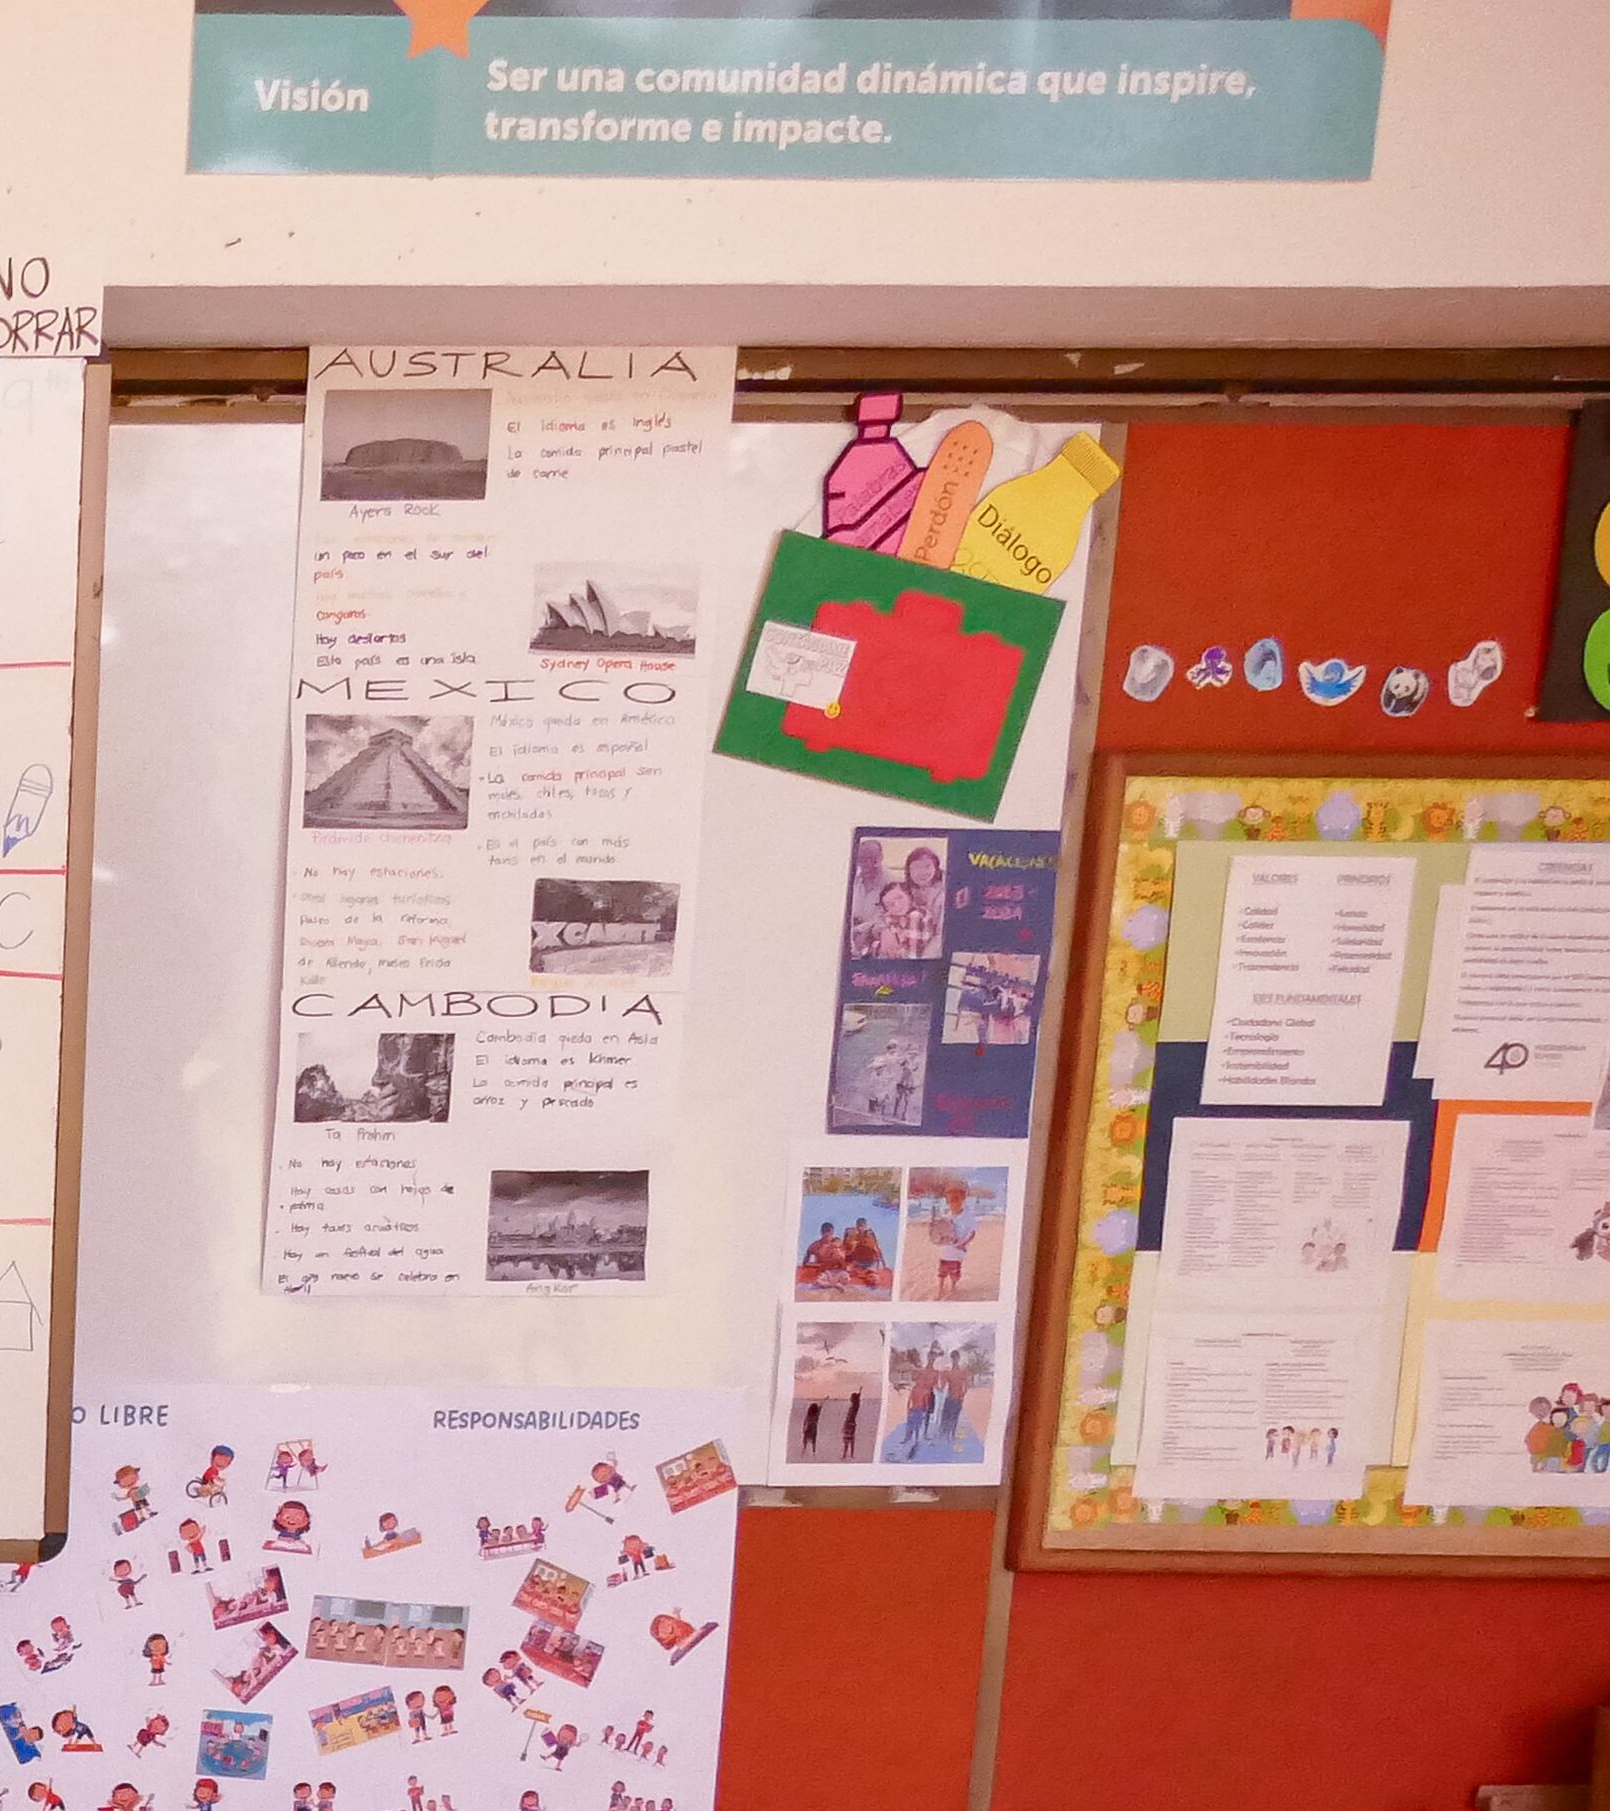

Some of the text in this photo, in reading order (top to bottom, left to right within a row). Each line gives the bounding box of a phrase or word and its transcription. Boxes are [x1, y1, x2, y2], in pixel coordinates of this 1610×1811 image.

[255, 77, 370, 114] Visión
[486, 60, 1258, 106] Ser una comunidad dinámica que inspire,
[484, 110, 893, 151] transforme e impacte.
[314, 348, 697, 382] AUSTRALIA
[915, 479, 959, 564] Perdón
[977, 503, 1053, 587] Diálogo
[540, 658, 589, 673] Sydney
[296, 677, 676, 703] MEXICO
[292, 992, 663, 1025] CAMBODIA
[1484, 1041, 1530, 1076] 40
[99, 1404, 169, 1427] LIBRE
[432, 1409, 641, 1433] RESPONSABILIDADES
